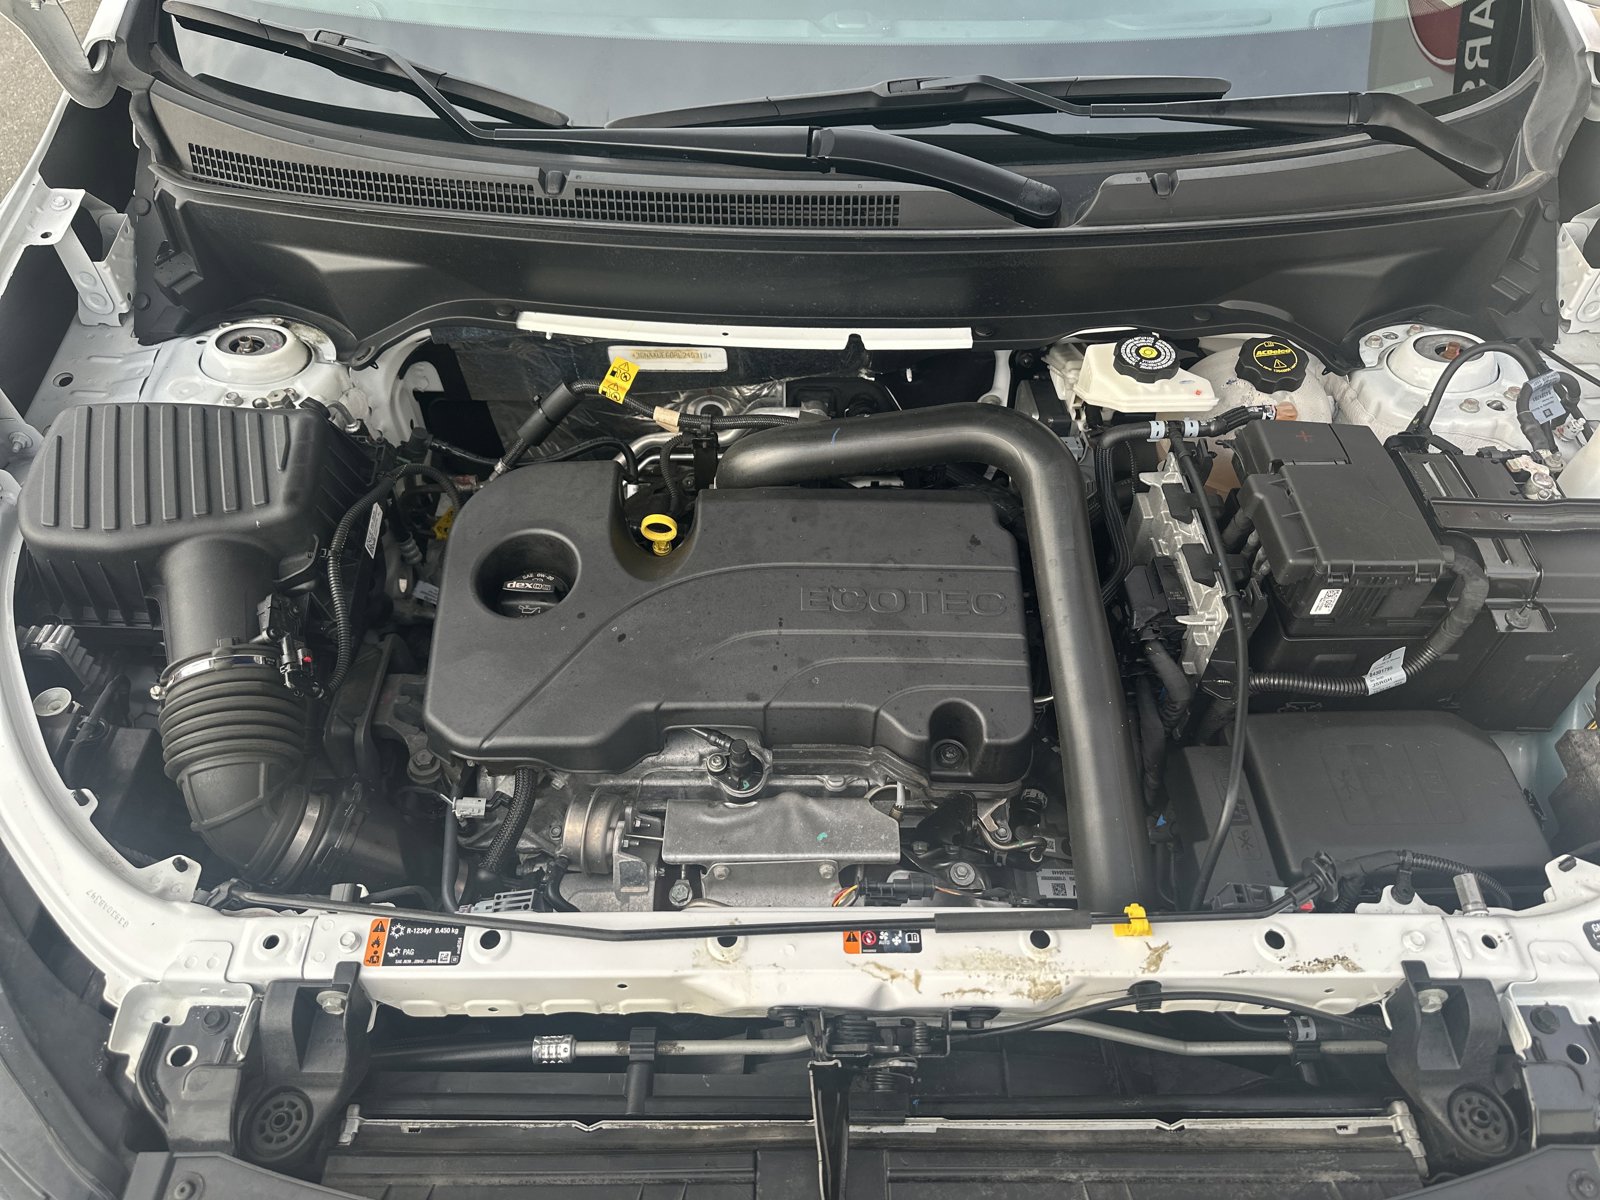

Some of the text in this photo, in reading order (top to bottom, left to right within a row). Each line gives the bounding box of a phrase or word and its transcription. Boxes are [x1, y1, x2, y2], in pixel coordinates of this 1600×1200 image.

[800, 586, 1007, 616] ECOTEC
[406, 927, 432, 936] R-1234yf
[451, 927, 459, 935] kg
[402, 948, 415, 956] PAG
